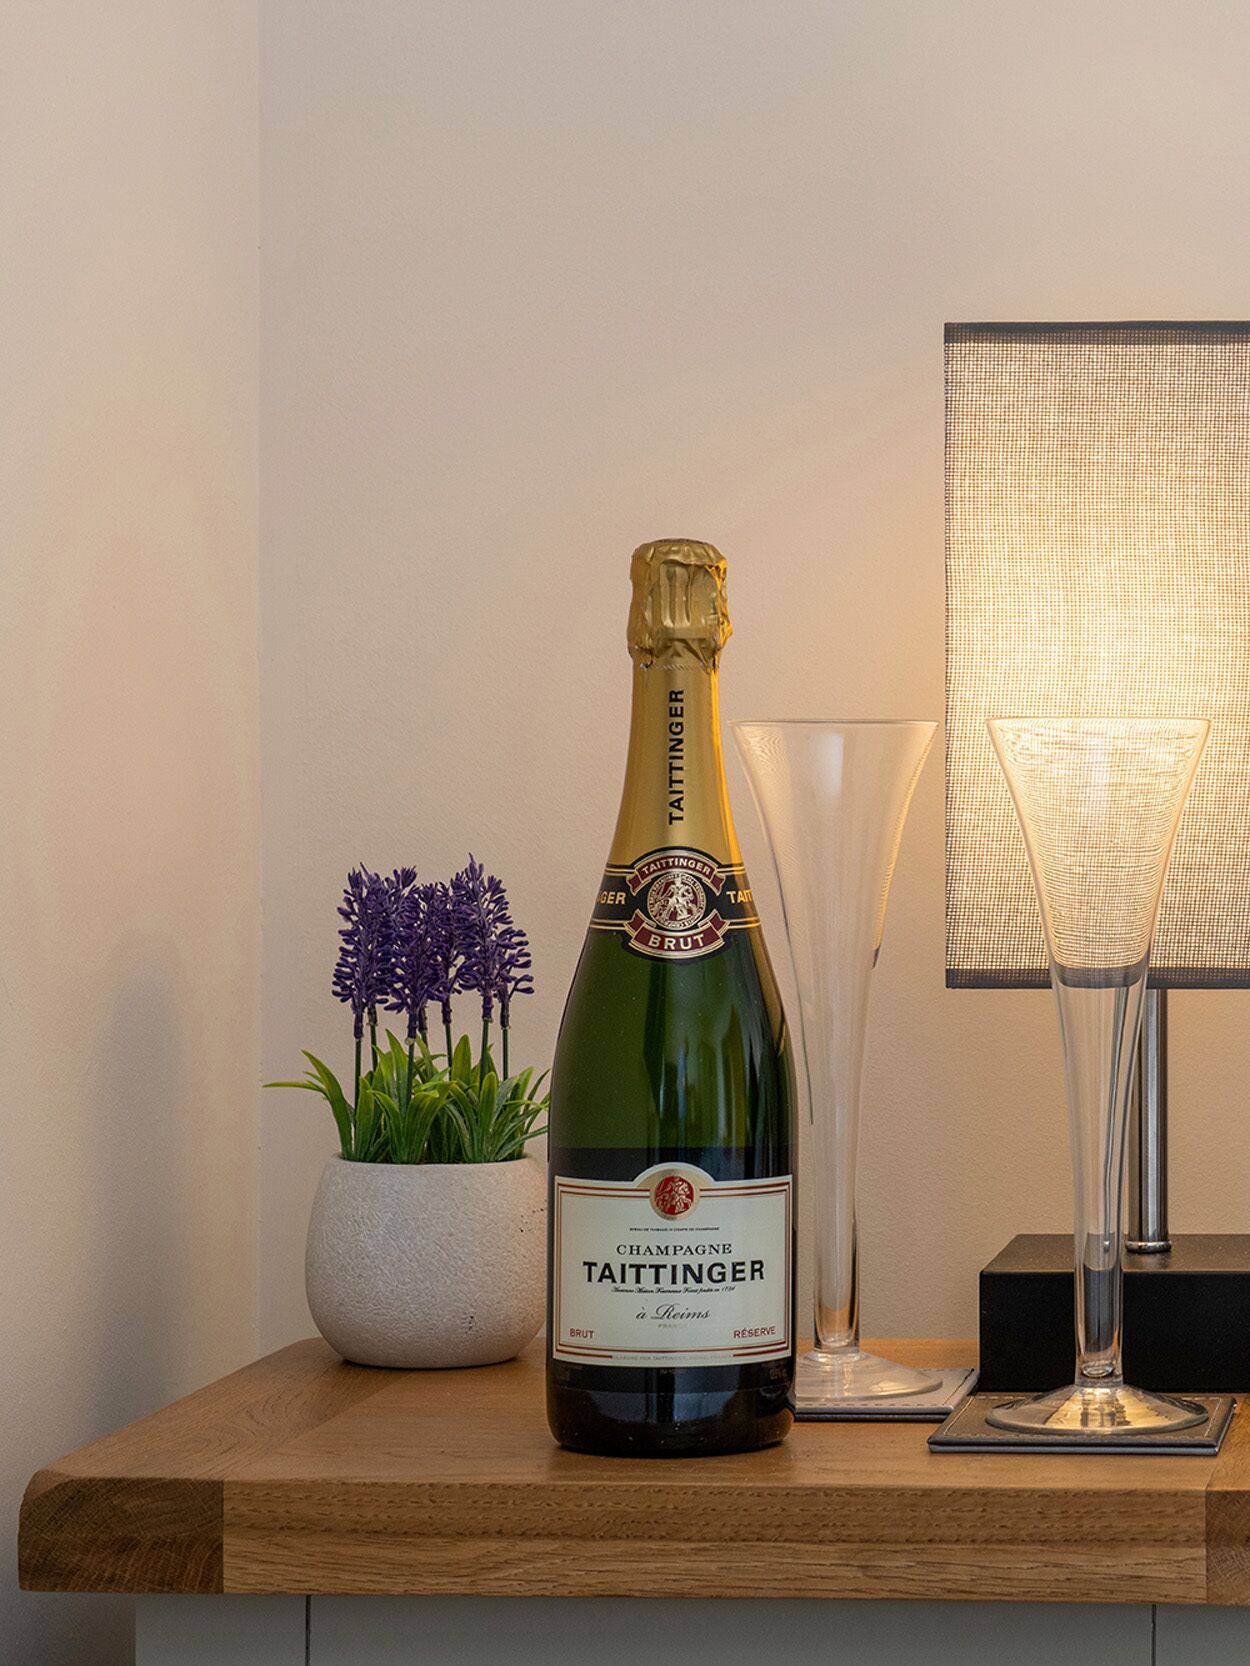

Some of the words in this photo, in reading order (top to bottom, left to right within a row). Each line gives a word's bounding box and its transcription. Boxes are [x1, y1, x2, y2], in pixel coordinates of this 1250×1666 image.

[668, 689, 685, 825] TAITTINGER
[641, 857, 712, 876] TAITTINGER
[648, 933, 706, 951] BRUT
[616, 1243, 733, 1257] CHAMPAGNE
[583, 1259, 765, 1285] TAITTINGER
[635, 1306, 648, 1320] à
[650, 1303, 711, 1321] Reims
[569, 1327, 595, 1339] BRUT
[733, 1325, 777, 1339] RÉSERVE
